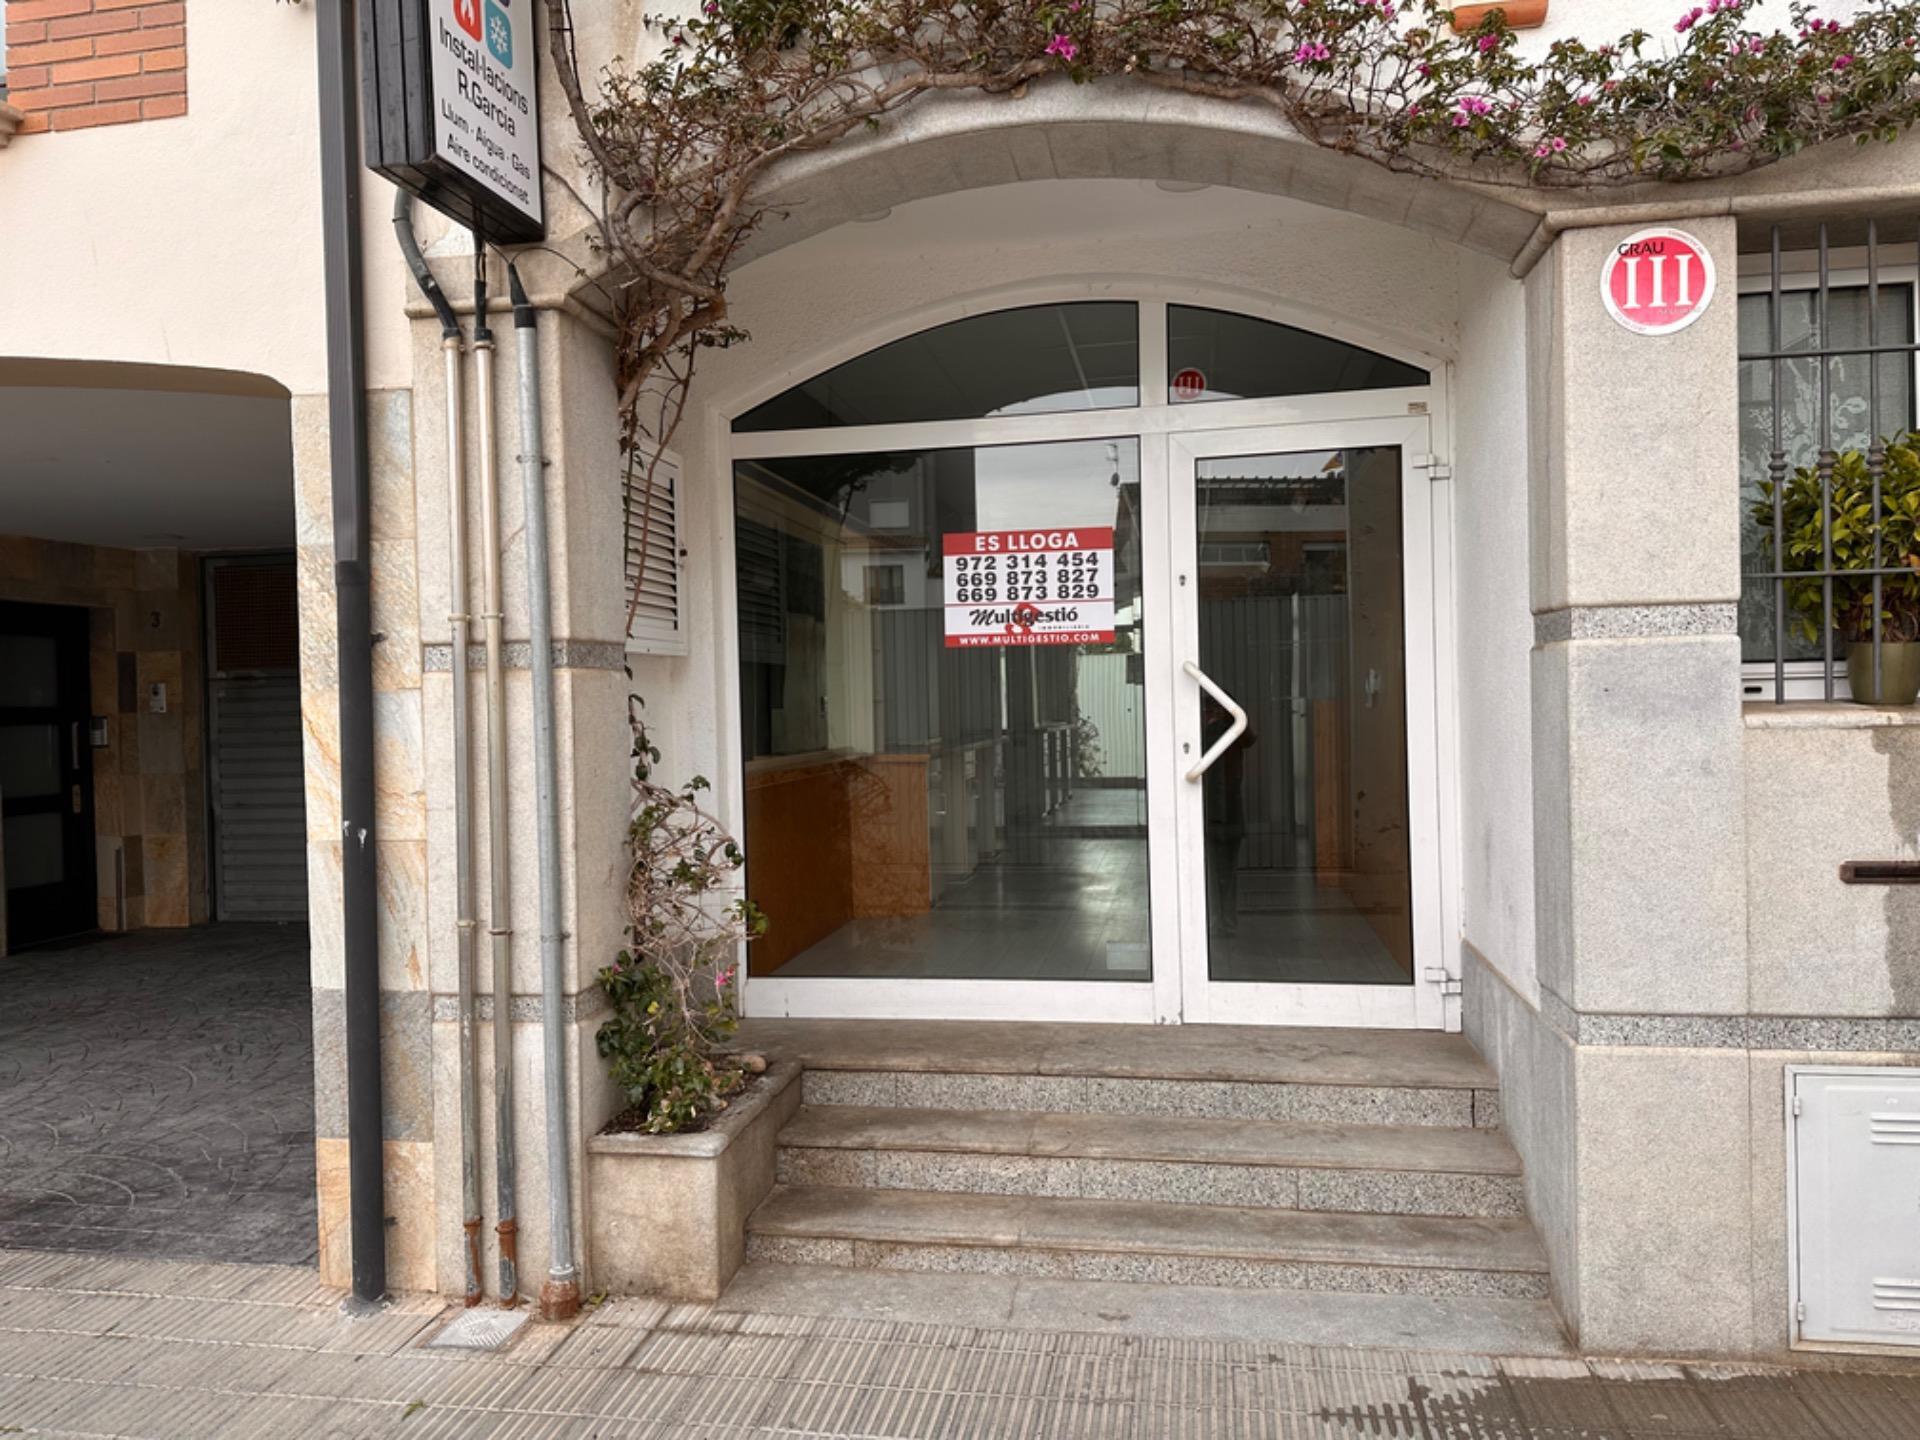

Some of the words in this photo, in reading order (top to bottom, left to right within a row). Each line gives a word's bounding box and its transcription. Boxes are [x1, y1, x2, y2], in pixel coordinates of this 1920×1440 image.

[441, 98, 469, 134] Llum
[475, 126, 505, 161] Aigua
[512, 153, 531, 180] Gas
[447, 134, 470, 163] Aire
[1617, 242, 1664, 256] GRAU
[1622, 254, 1694, 309] III
[975, 535, 1000, 551] ES
[1007, 532, 1078, 550] LLOGA
[955, 556, 997, 571] 972
[1006, 554, 1047, 570] 314
[1057, 552, 1099, 567] 454
[956, 572, 997, 587] 669
[1006, 571, 1048, 585] 873
[1057, 568, 1099, 583] 827
[956, 588, 997, 602] 669
[1006, 586, 1048, 600] 873
[1057, 584, 1099, 599] 829
[150, 610, 161, 628] 3
[969, 607, 1078, 627] Multigestió
[959, 633, 1100, 645] WWW.MULTIGESTIO.COM
